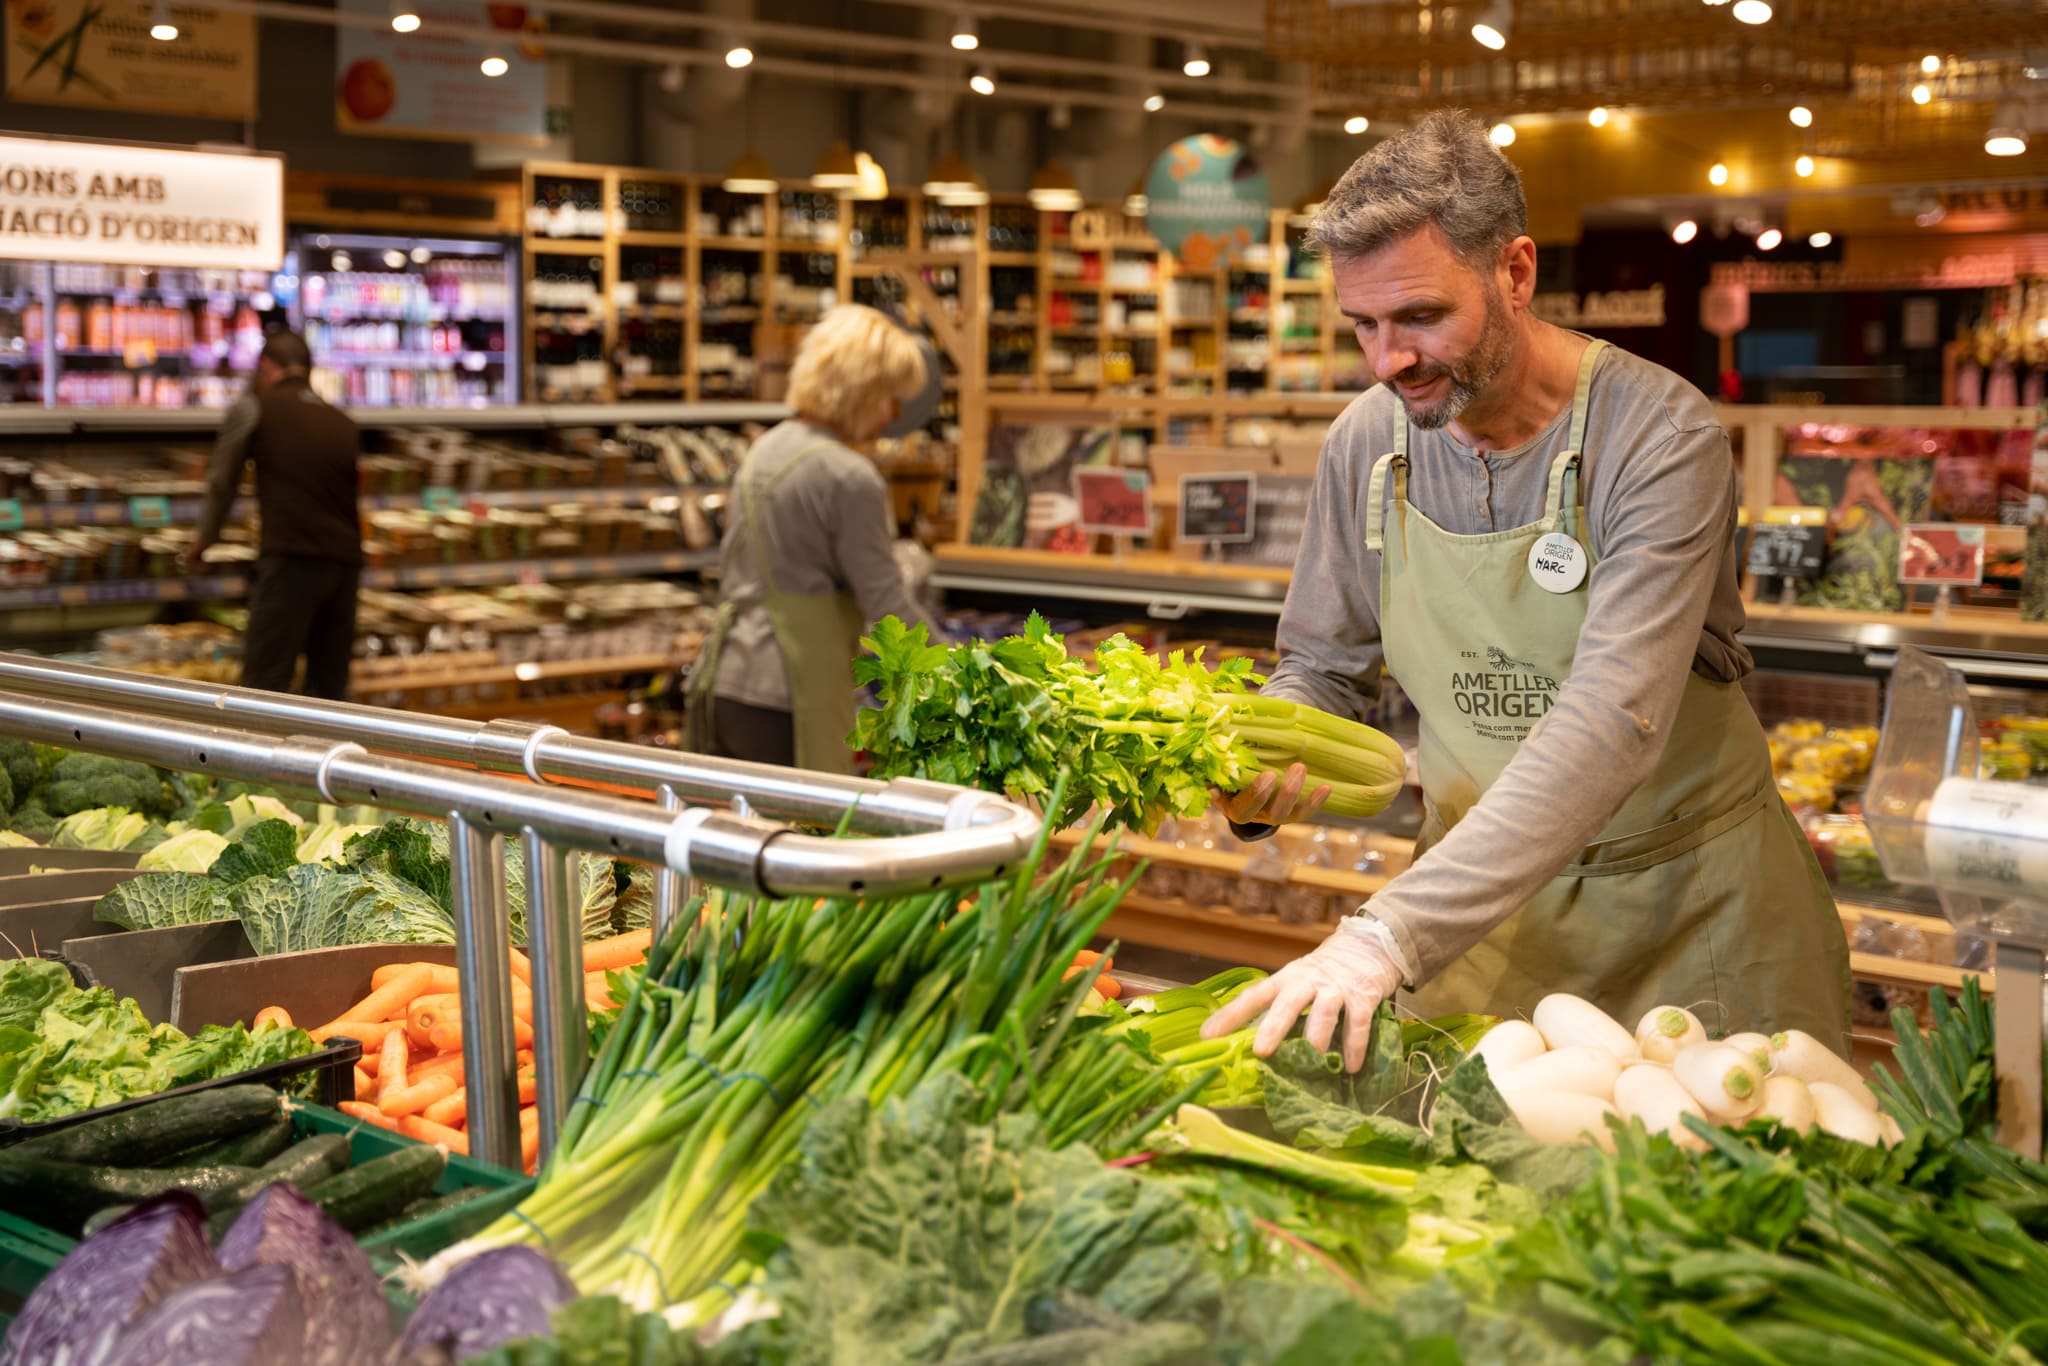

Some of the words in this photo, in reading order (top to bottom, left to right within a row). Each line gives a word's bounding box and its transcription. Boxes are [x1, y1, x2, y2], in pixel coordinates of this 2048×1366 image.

[0, 167, 77, 199] ONS
[88, 173, 166, 200] AMB
[0, 203, 90, 238] ACIÓ
[1544, 547, 1573, 562] ORIGEN
[1545, 542, 1574, 555] AMETLLER
[1535, 556, 1566, 574] MARC
[1461, 651, 1479, 659] EST.
[1452, 672, 1560, 691] AMETLLER
